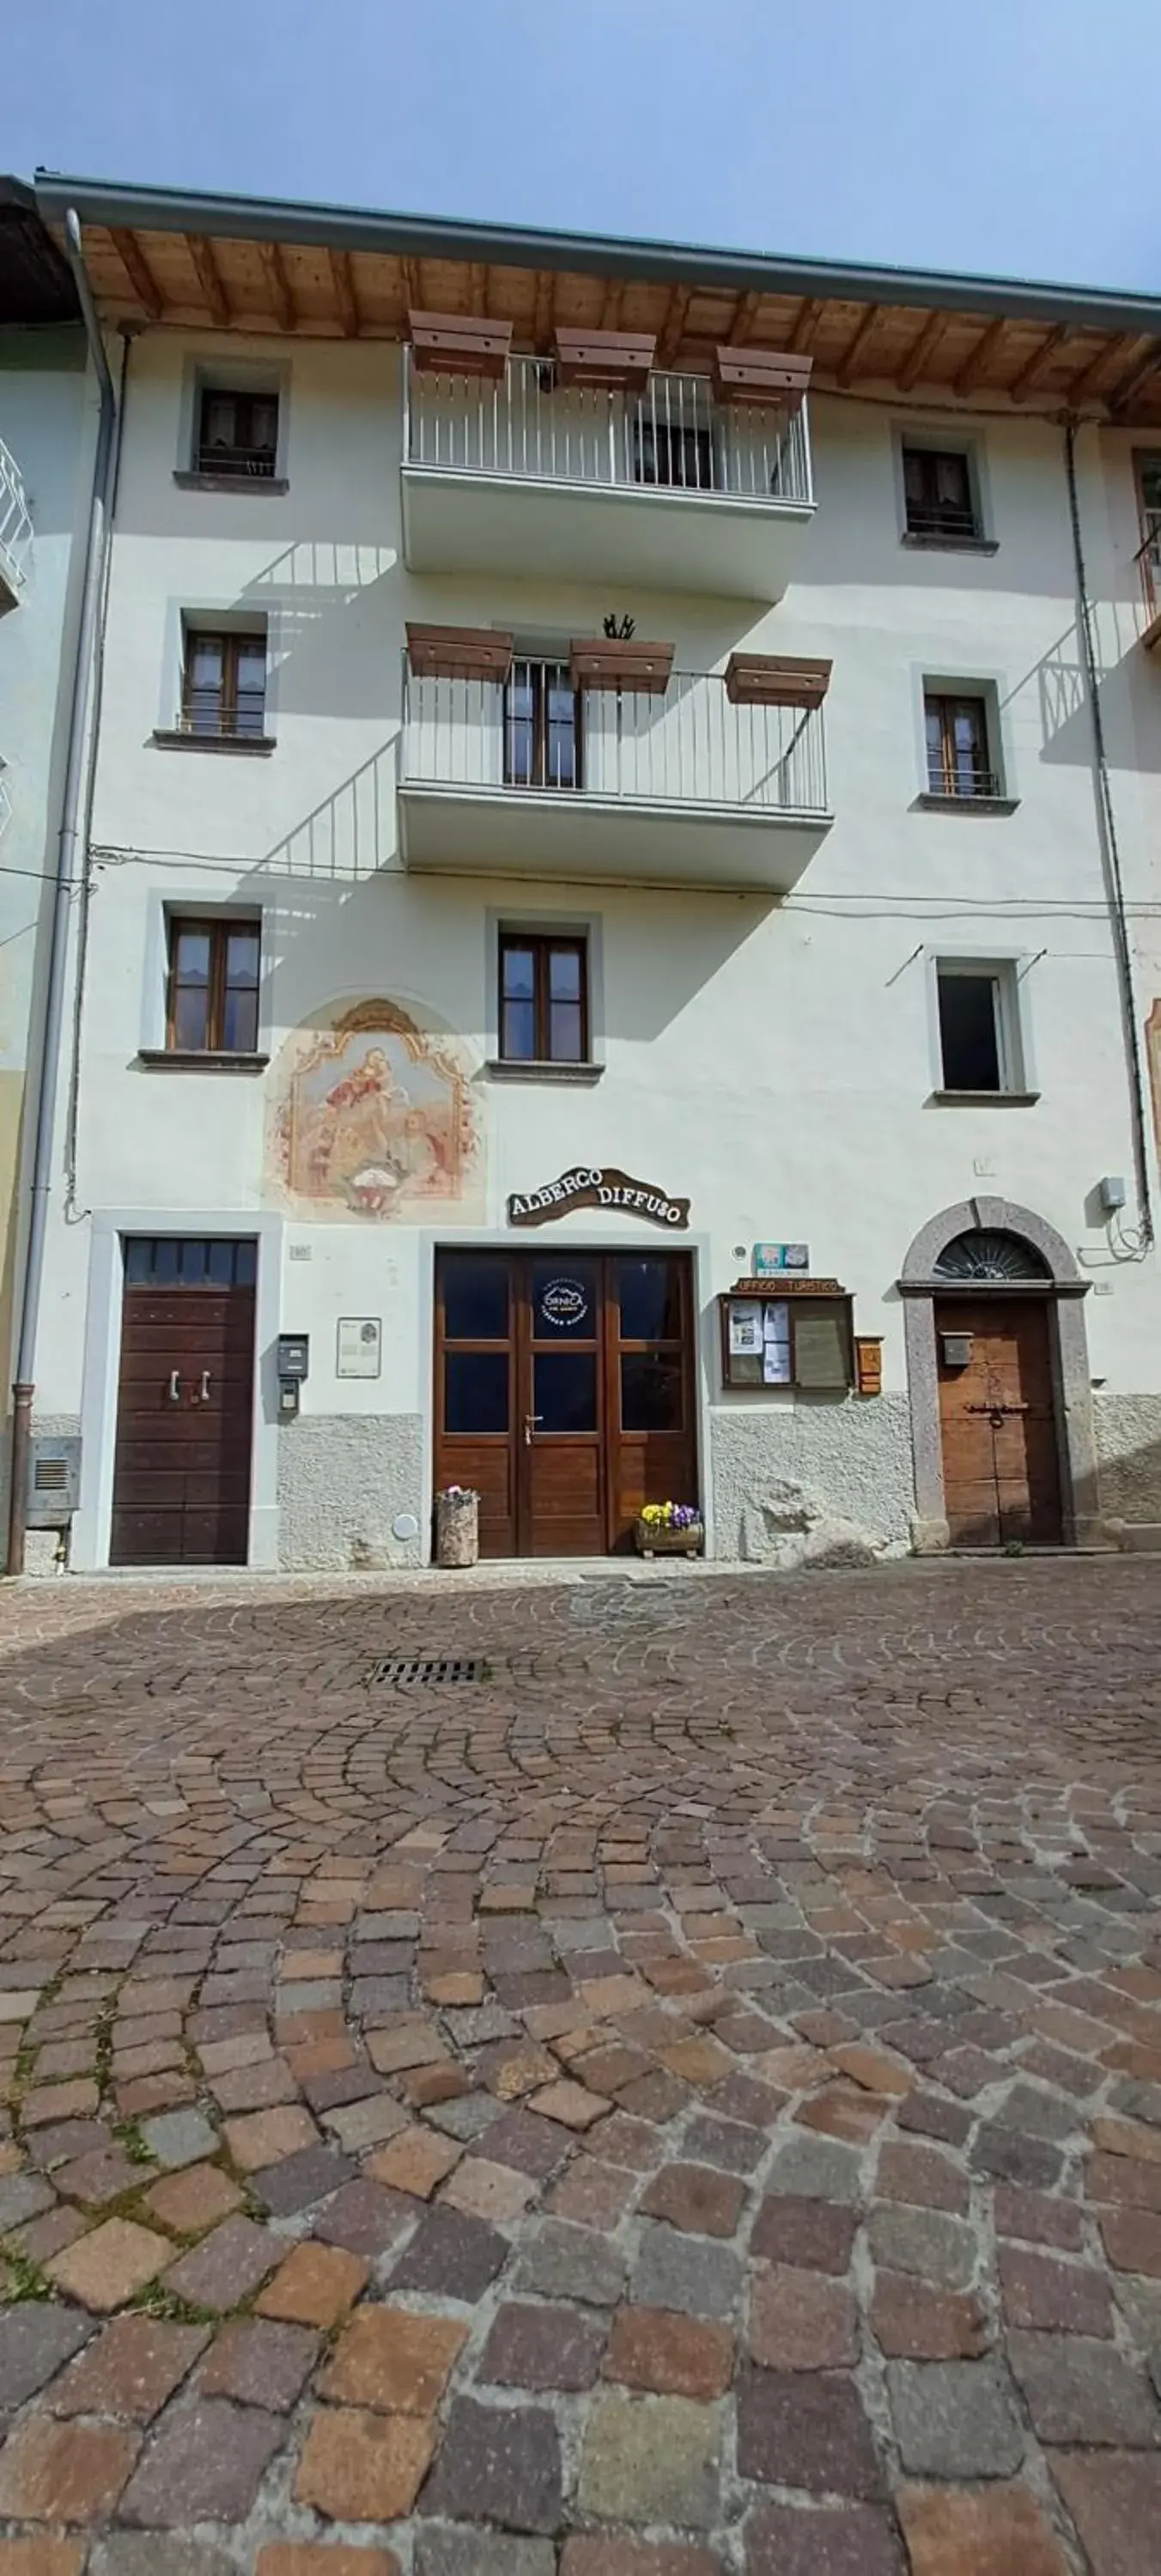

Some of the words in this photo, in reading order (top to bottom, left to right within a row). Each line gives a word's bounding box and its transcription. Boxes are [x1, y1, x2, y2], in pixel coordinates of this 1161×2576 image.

[598, 1187, 681, 1223] DIFFUSO
[739, 1280, 776, 1291] UFFICIO
[788, 1280, 837, 1291] TURISTICO
